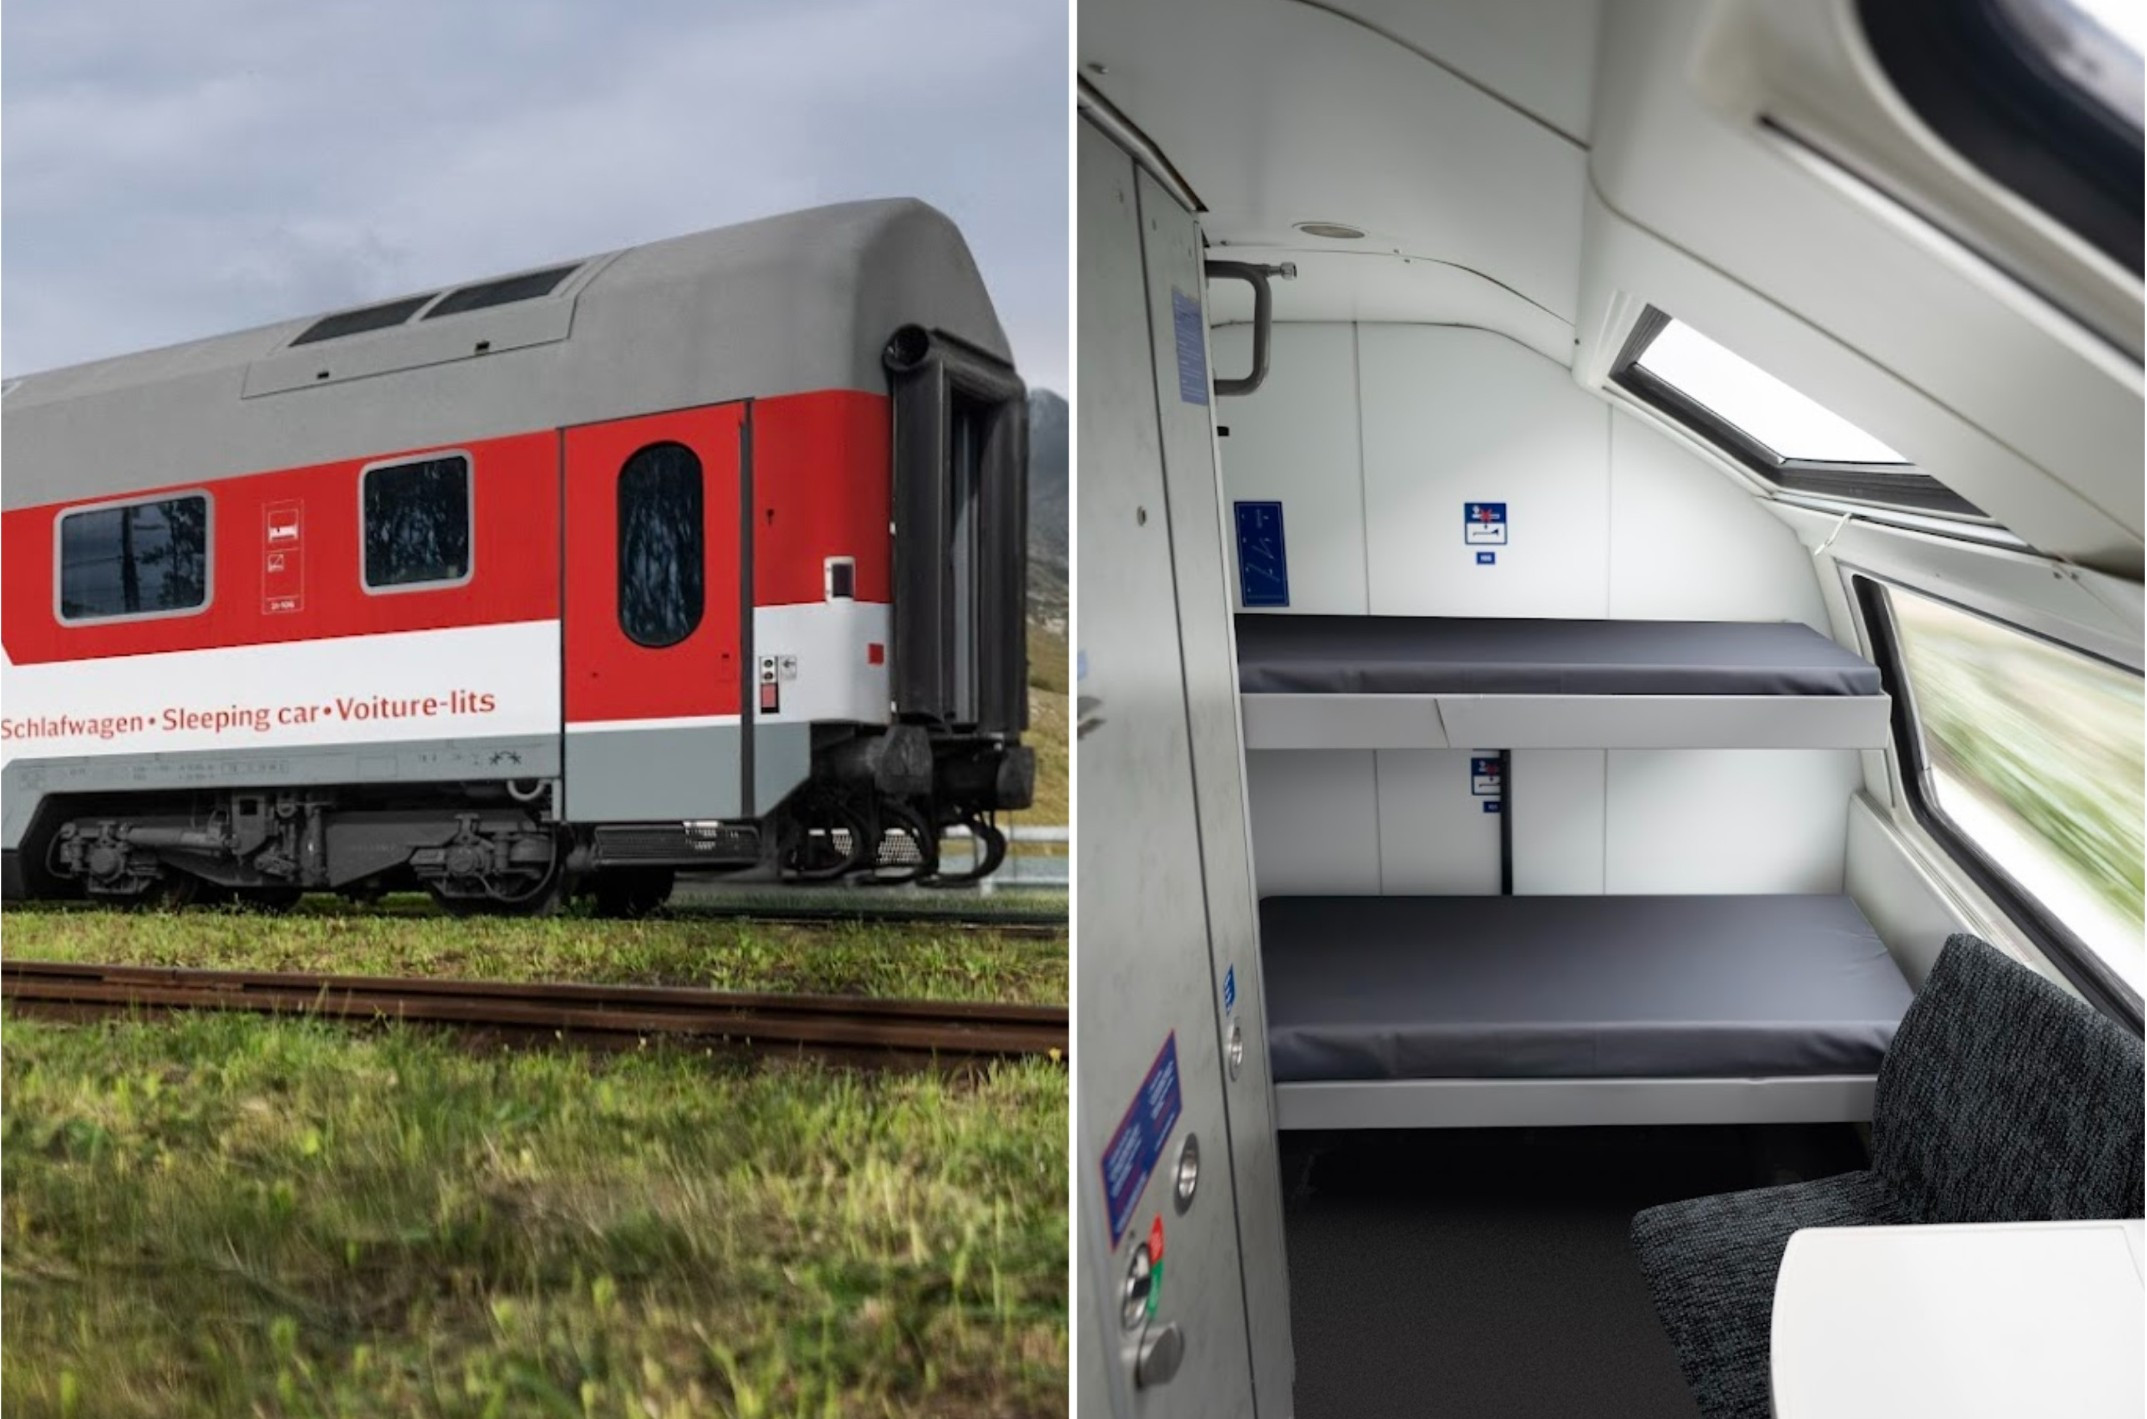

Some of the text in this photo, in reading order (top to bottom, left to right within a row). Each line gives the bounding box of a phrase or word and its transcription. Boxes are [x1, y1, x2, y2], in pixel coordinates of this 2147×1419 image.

[1, 690, 496, 740] Schlafwagen Sleeping car Voiture-lits
